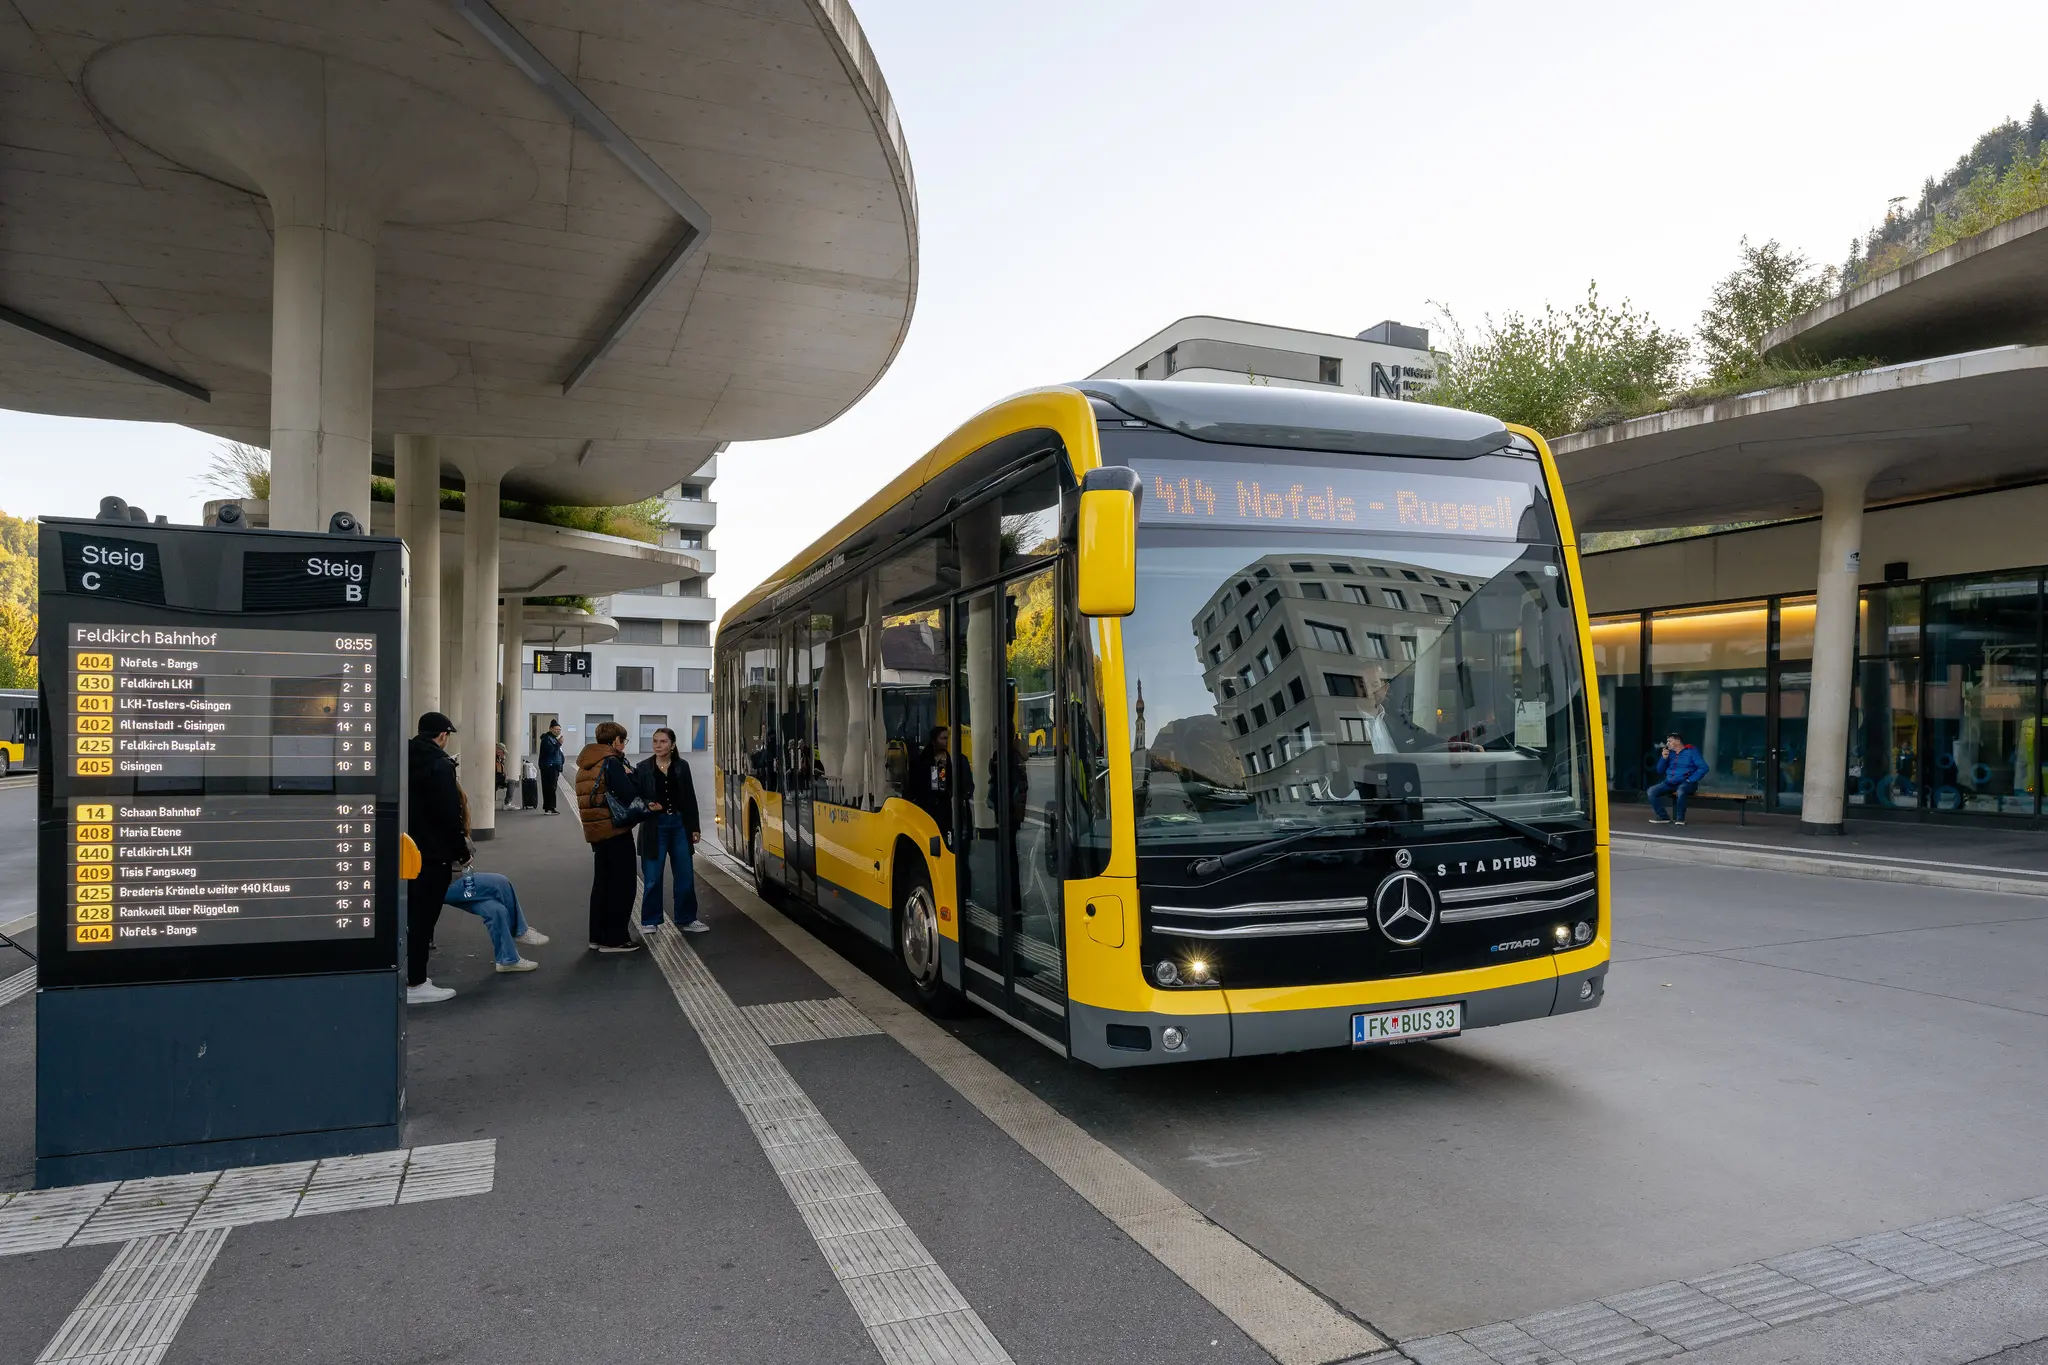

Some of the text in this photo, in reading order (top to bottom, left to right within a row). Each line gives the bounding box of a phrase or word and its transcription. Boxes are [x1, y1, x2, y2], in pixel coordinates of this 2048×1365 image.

[1154, 476, 1216, 516] 414
[1237, 480, 1357, 522] Nofels
[1396, 489, 1513, 531] Ruggell
[82, 545, 144, 571] Steig
[306, 557, 364, 582] Steig
[81, 571, 101, 591] C
[346, 584, 363, 602] B
[77, 628, 373, 650] Feldkirch Bahnhof 08:55
[79, 656, 112, 668] 404
[120, 658, 158, 668] Nofels
[167, 658, 198, 671] Bangs
[364, 664, 372, 673] B
[577, 658, 586, 670] B
[79, 677, 110, 689] 430
[120, 678, 170, 689] Feldkirch
[171, 679, 193, 689] LKH
[364, 683, 372, 693] B
[79, 698, 109, 710] 401
[120, 699, 231, 712] LKH-Tosters-Gisingen
[364, 703, 372, 712] B
[79, 719, 111, 731] 402
[120, 720, 174, 730] Altenstadt
[184, 720, 225, 732] Gisingen
[364, 722, 372, 732] A
[79, 740, 111, 752] 425
[120, 740, 169, 751] Feldkirch
[171, 741, 216, 753] Busplatz
[364, 742, 372, 751] B
[79, 761, 111, 773] 405
[120, 761, 163, 773] Gisingen
[364, 761, 372, 771] B
[86, 807, 106, 820] 14
[120, 807, 158, 817] Schaan
[159, 806, 202, 817] Bahnhof
[361, 804, 374, 815] 12
[79, 827, 110, 840] 408
[120, 827, 149, 837] Maria
[150, 827, 182, 837] Ebene
[364, 823, 371, 833] B
[79, 848, 109, 860] 440
[120, 846, 169, 857] Feldkirch
[171, 846, 192, 856] LKH
[364, 842, 371, 852] B
[79, 867, 110, 880] 409
[120, 867, 144, 877] Tisis
[145, 866, 197, 878] Fangsweg
[364, 861, 371, 871] B
[1437, 854, 1537, 876] STADTBUS
[79, 888, 110, 900] 425
[120, 886, 164, 897] Brederis
[165, 885, 206, 896] Krönele
[207, 884, 239, 895] weiter
[240, 883, 261, 894] 440
[262, 883, 291, 893] Klaus
[363, 880, 371, 890] A
[79, 908, 110, 920] 428
[120, 906, 166, 917] Rankweil
[168, 906, 192, 915] über
[193, 904, 240, 916] Rüggelen
[363, 899, 371, 908] A
[79, 928, 111, 940] 404
[120, 926, 157, 937] Nofels
[166, 925, 198, 936] Bangs
[363, 917, 370, 927] B
[1369, 1009, 1455, 1037] FK BUS 33
